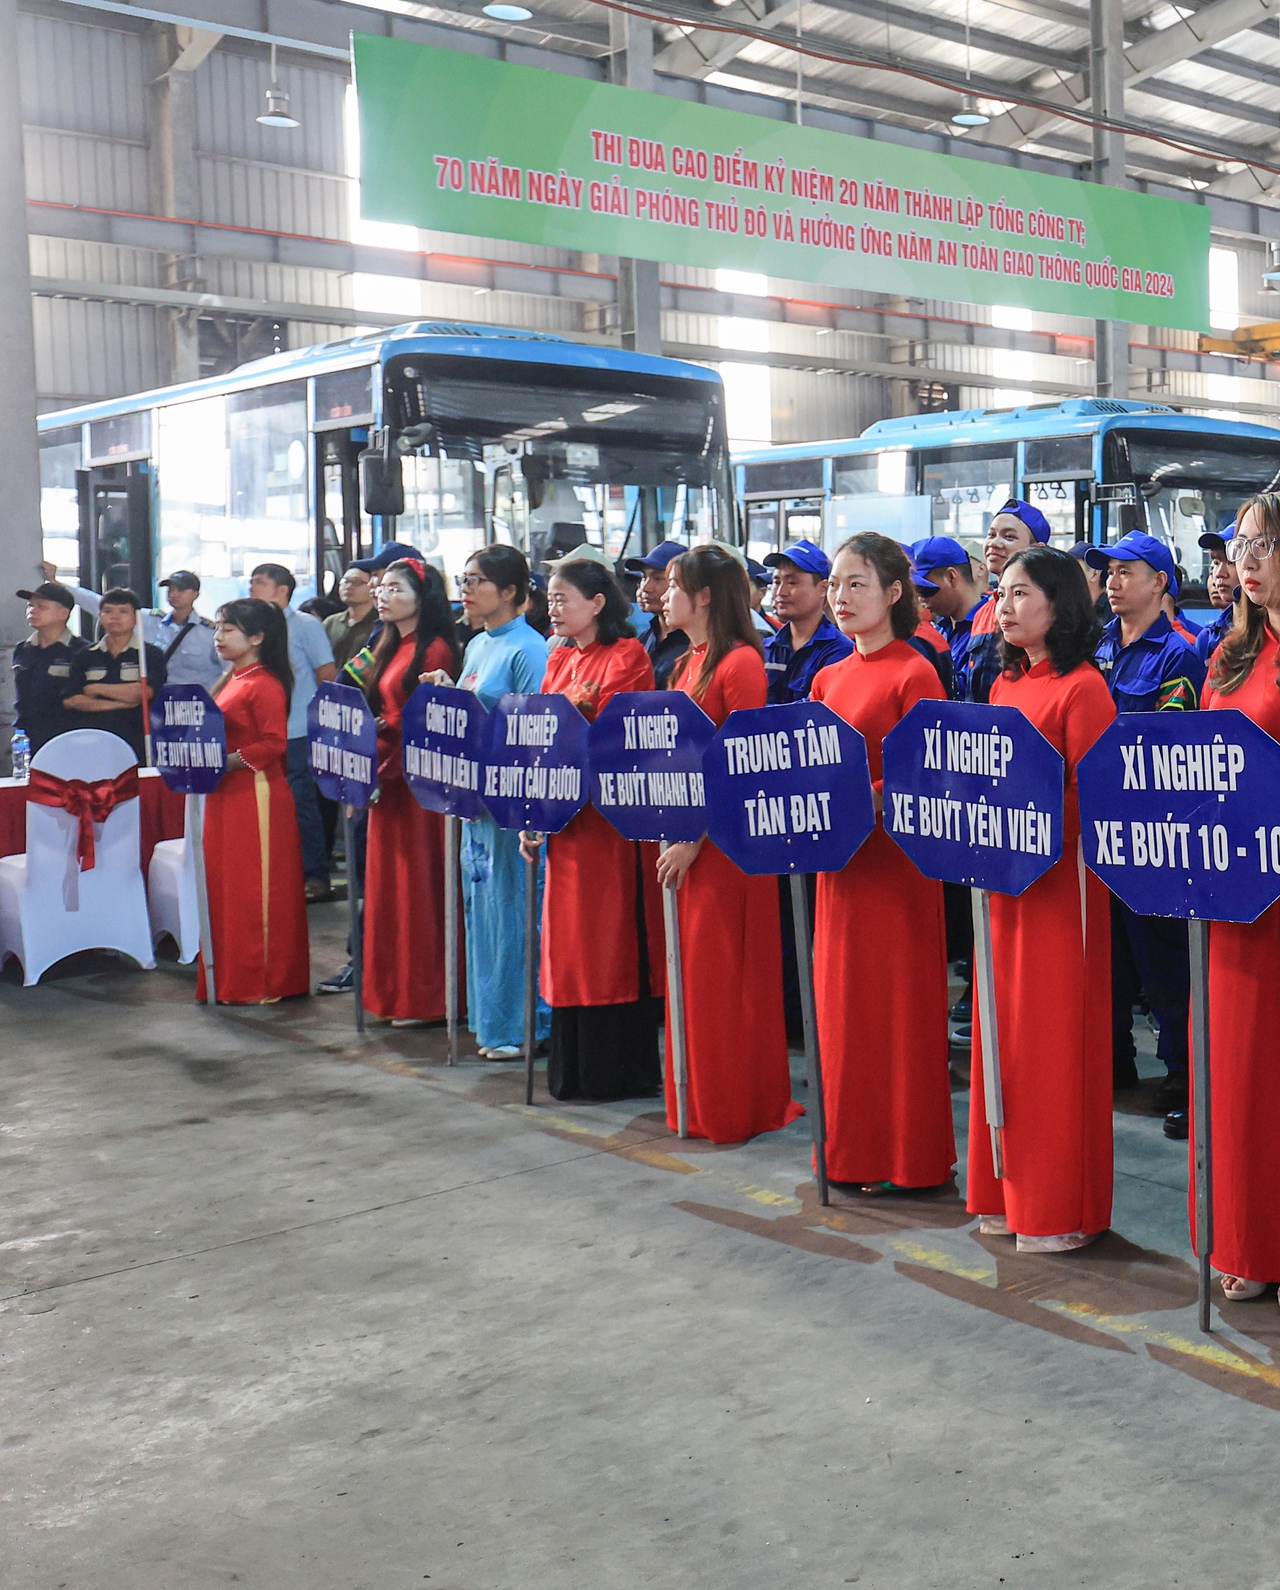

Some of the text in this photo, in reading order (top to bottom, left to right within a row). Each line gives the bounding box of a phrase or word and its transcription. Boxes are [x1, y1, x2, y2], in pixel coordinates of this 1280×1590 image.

[591, 130, 622, 165] THI
[628, 136, 667, 173] ĐUA
[671, 144, 708, 181] CAO
[713, 146, 759, 190] ĐIỂM
[764, 156, 786, 193] KỶ
[791, 166, 834, 206] NIỆM
[839, 178, 859, 206] 20
[863, 178, 899, 214] NĂM
[903, 187, 953, 222] THÀNH
[957, 196, 984, 232] LẬP
[988, 196, 1024, 235] TỔNG
[1028, 206, 1064, 241] CÔNG
[434, 155, 1175, 299] 70 NĂM NGÀY GIẢI PHÓNG THỦ ĐÔ VÀ HƯỞNG ỨNG NĂM AN TOÀN GIAO THÔNG QUỐC GIA 2024
[156, 741, 168, 766] XE
[505, 708, 558, 753] XÍ NGHIỆP
[623, 707, 679, 756] XÍ NGHIỆP
[723, 719, 842, 776] TRUNG TÂM
[923, 720, 1014, 787] XÍ NGHIỆP
[484, 765, 498, 796] XE
[499, 759, 524, 798] BUÝT
[598, 765, 706, 807] XE BUÝT NHANH BR
[1119, 733, 1245, 802] XÍ NGHIỆP
[744, 789, 831, 841] TÂN ĐẠT
[891, 790, 1052, 857] XE BUÝT YÊN VIÊN
[1093, 820, 1126, 866] XE
[1130, 812, 1190, 869] BUÝT
[1197, 824, 1229, 872] 10
